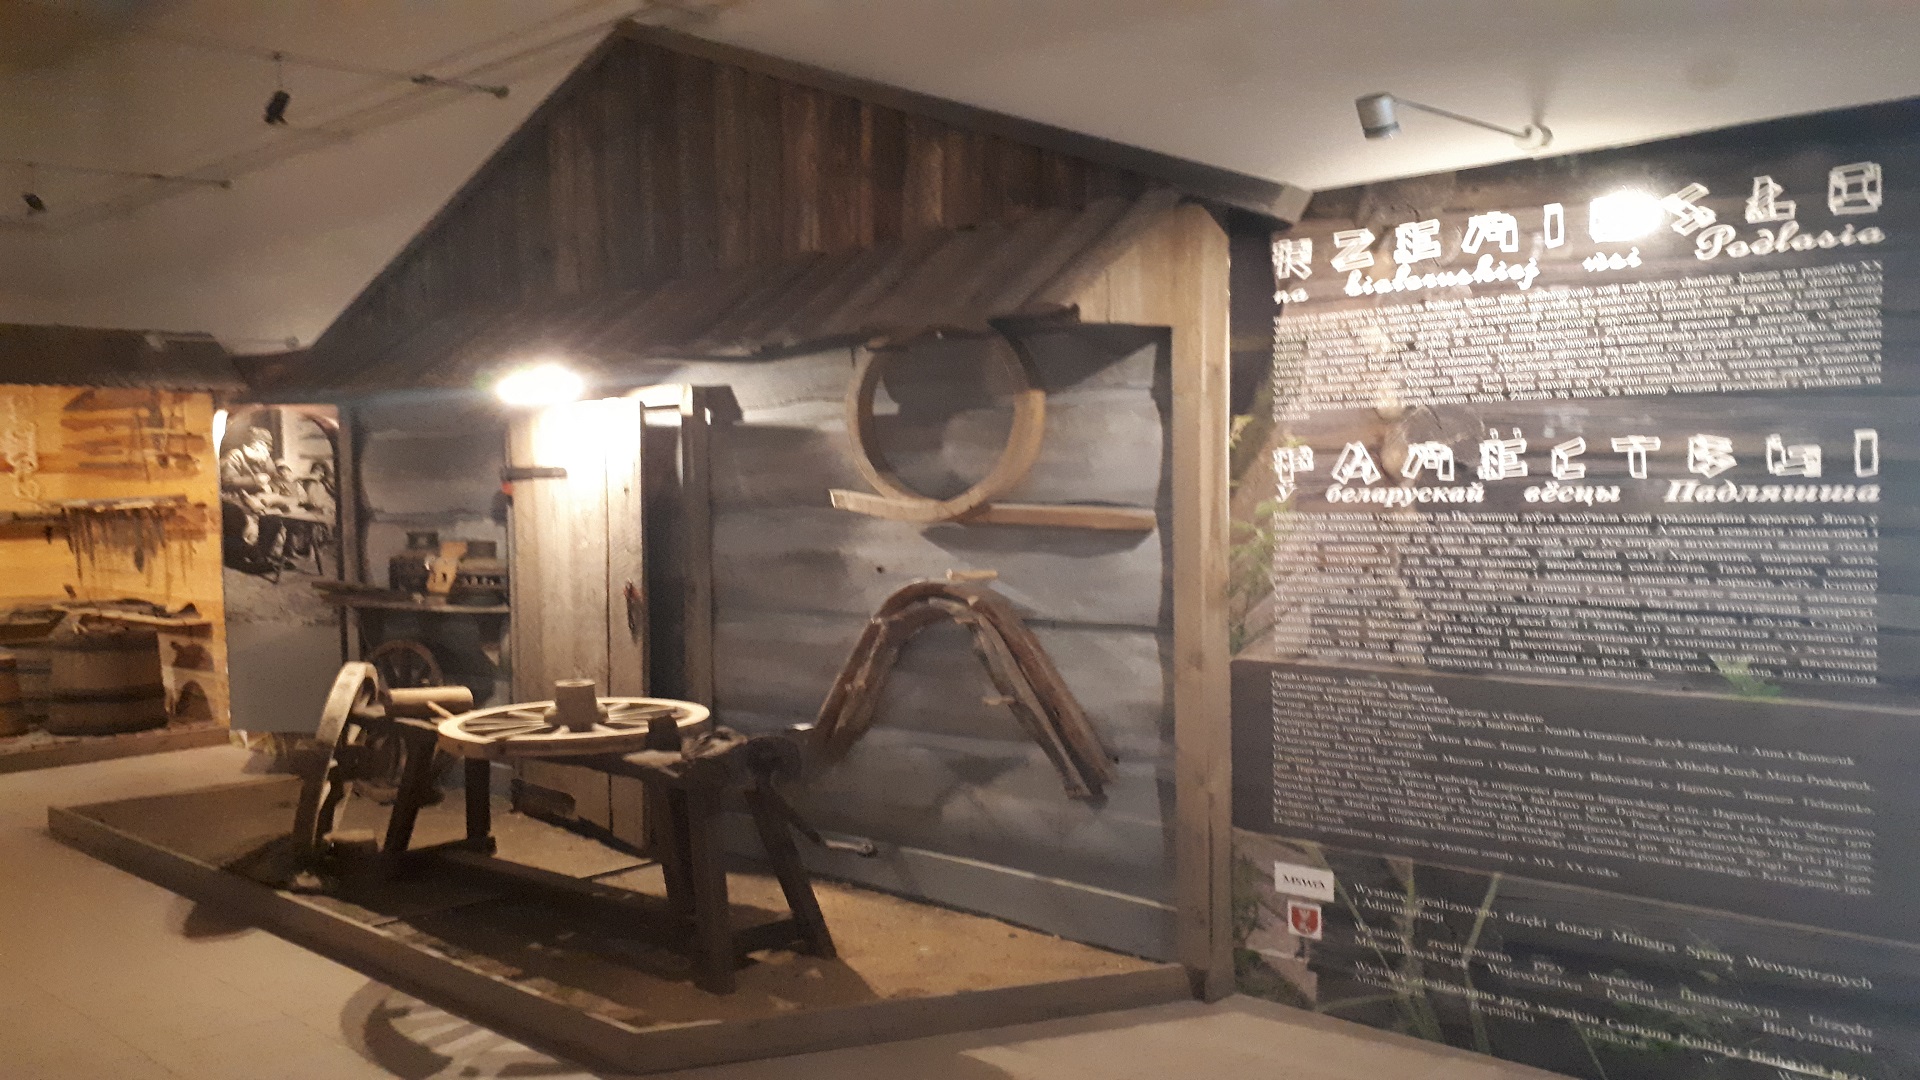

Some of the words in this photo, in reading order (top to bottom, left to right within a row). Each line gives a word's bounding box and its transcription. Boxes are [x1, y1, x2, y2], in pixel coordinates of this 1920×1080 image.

[1272, 161, 1884, 281] RZEMISŁO
[1694, 220, 1886, 261] Podlasia
[1325, 481, 1484, 508] беларускай
[1523, 481, 1621, 506] вёсцы
[1664, 478, 1881, 503] Падляшша
[1505, 911, 1547, 928] dzięki
[1555, 920, 1603, 940] dotacji
[1611, 930, 1676, 952] Ministra
[1533, 960, 1564, 975] przy
